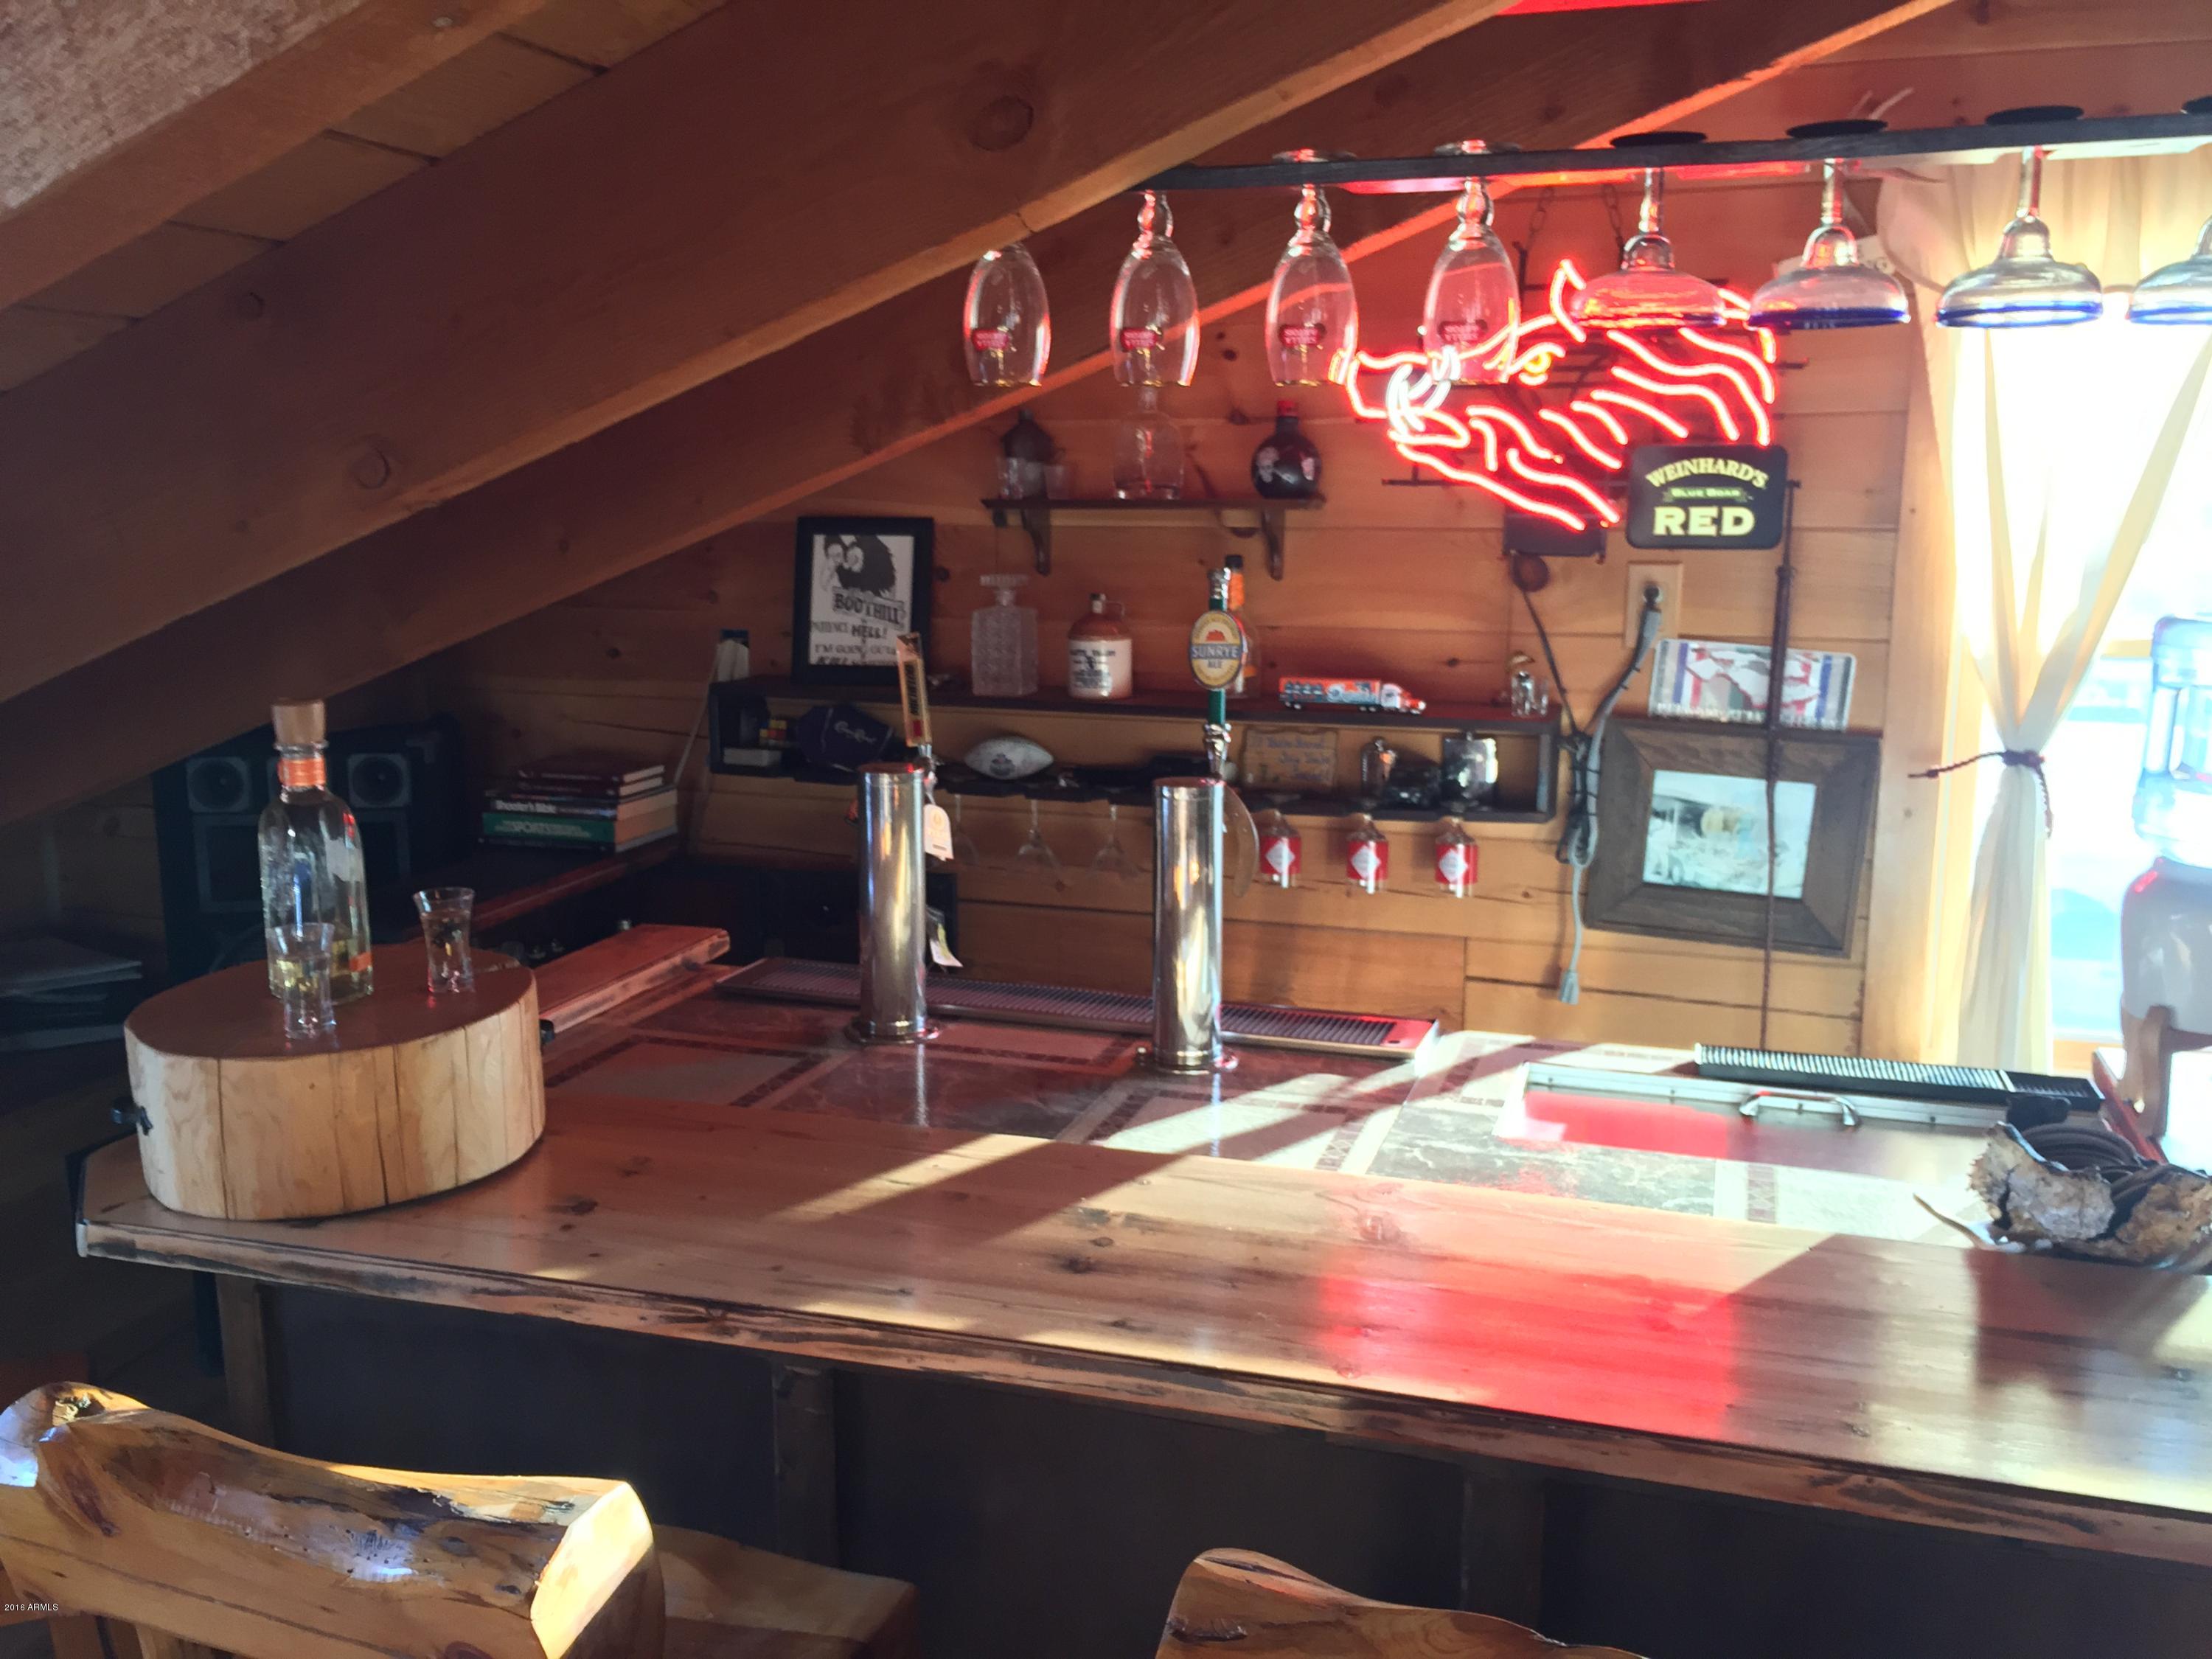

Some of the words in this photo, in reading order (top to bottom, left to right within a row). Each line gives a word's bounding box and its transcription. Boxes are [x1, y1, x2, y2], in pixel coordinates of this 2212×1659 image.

[1645, 457, 1770, 489] WEINHARD'S
[1653, 506, 1756, 536] RED
[1192, 644, 1239, 658] SUNRYE
